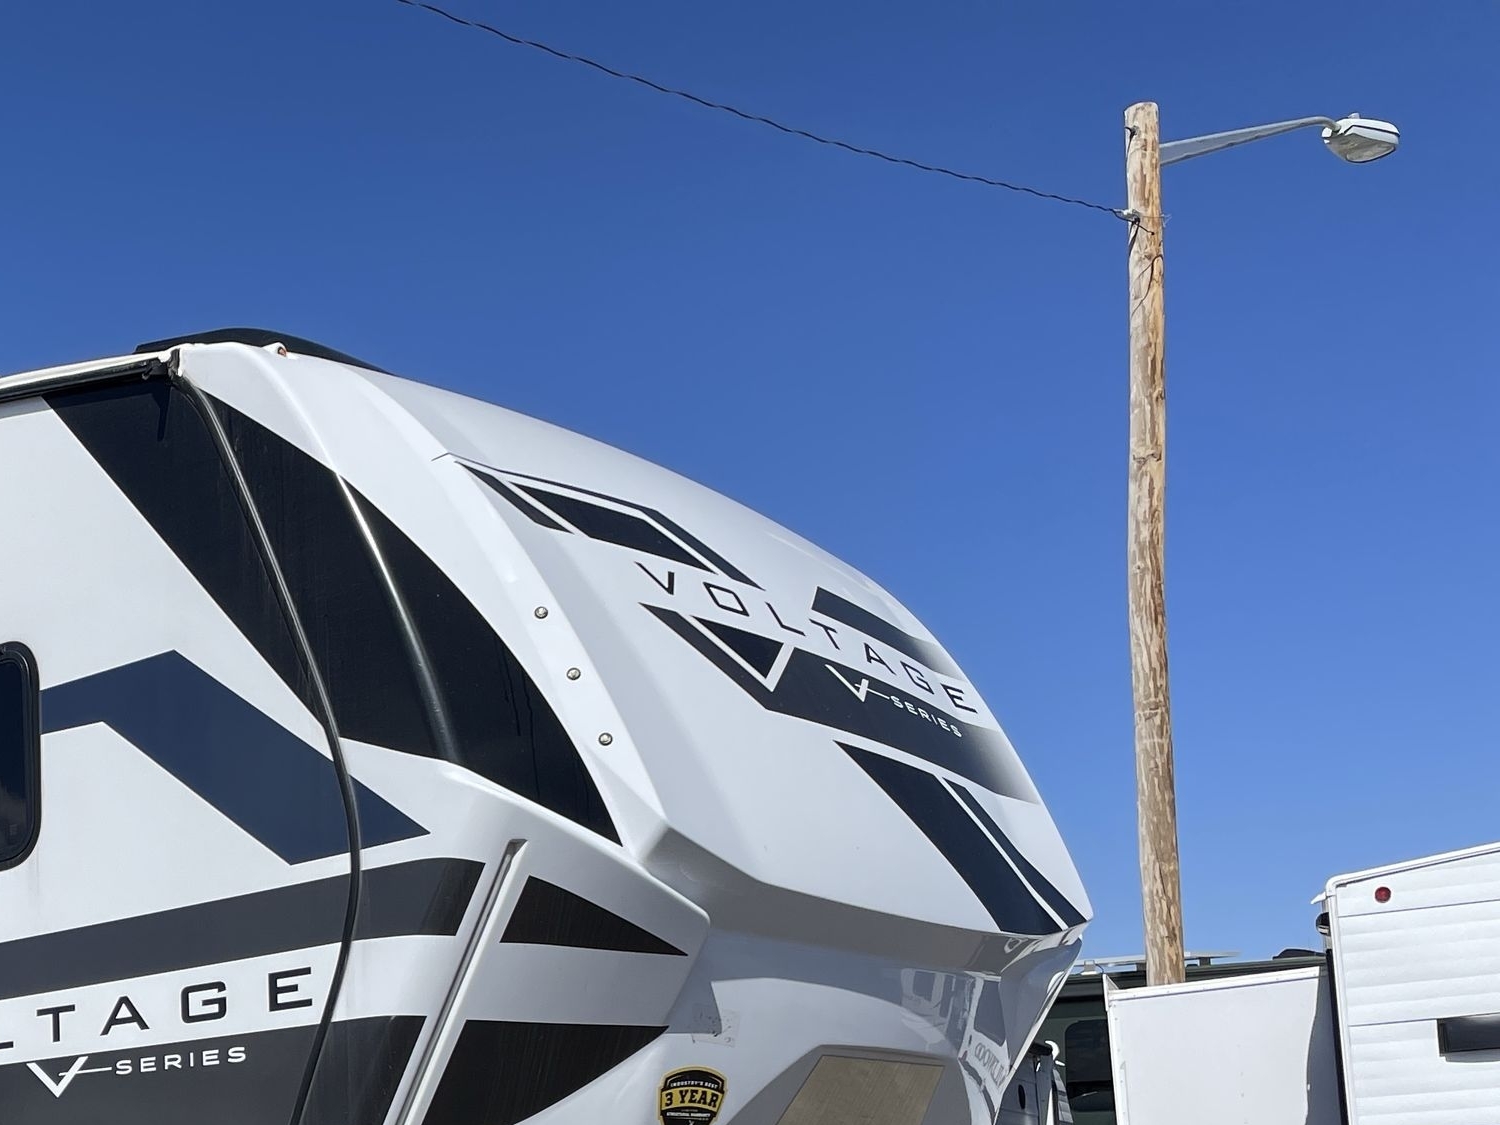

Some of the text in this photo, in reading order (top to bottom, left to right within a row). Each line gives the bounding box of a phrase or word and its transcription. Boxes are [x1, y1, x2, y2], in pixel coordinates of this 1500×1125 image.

[634, 561, 977, 714] VOLTAGE
[890, 695, 962, 738] SERIES
[115, 1046, 247, 1075] SERIES
[665, 1088, 720, 1109] 3 YEAR
